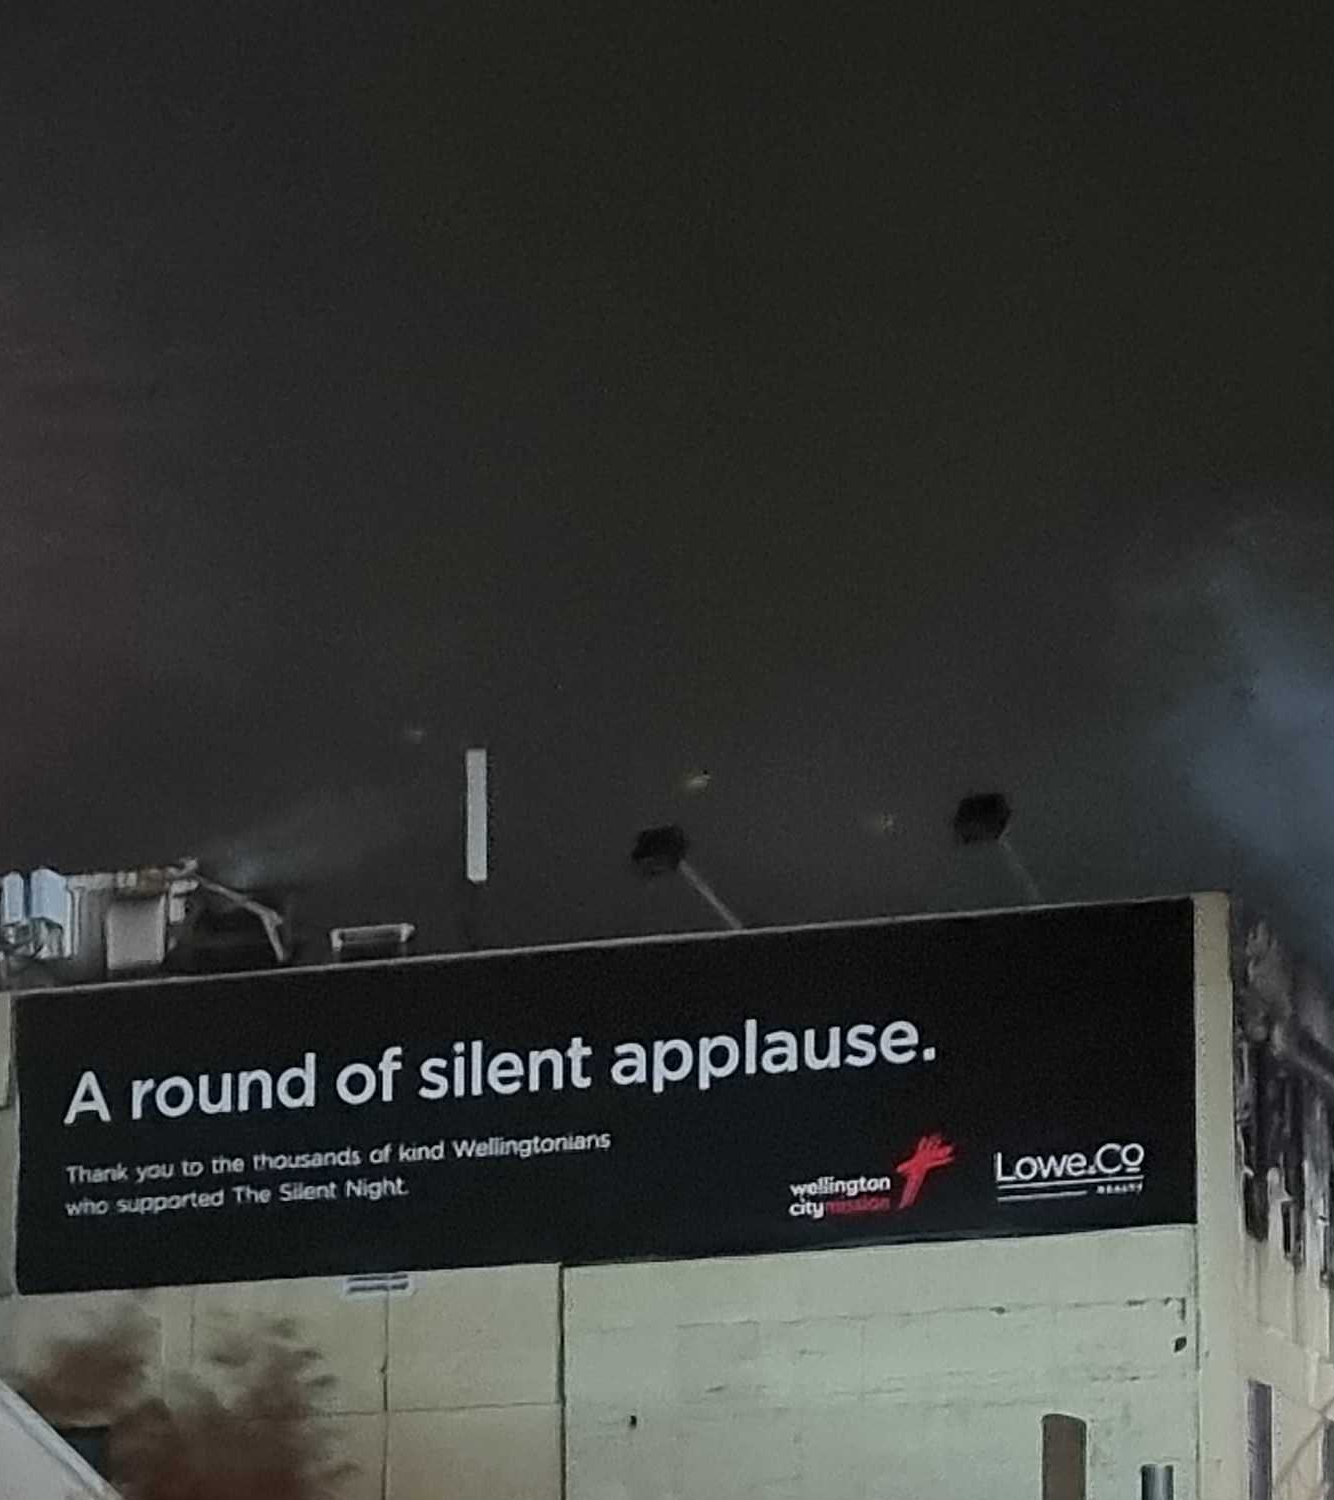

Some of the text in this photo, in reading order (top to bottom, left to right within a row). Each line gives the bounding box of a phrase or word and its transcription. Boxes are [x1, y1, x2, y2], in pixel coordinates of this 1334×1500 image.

[63, 1018, 937, 1126] A round of silent applause.
[67, 1130, 612, 1186] Thank you to the thousands of kind Wellingtonians
[67, 1174, 410, 1217] who supported The Silent Night.
[788, 1197, 825, 1219] city
[789, 1175, 892, 1200] wellington
